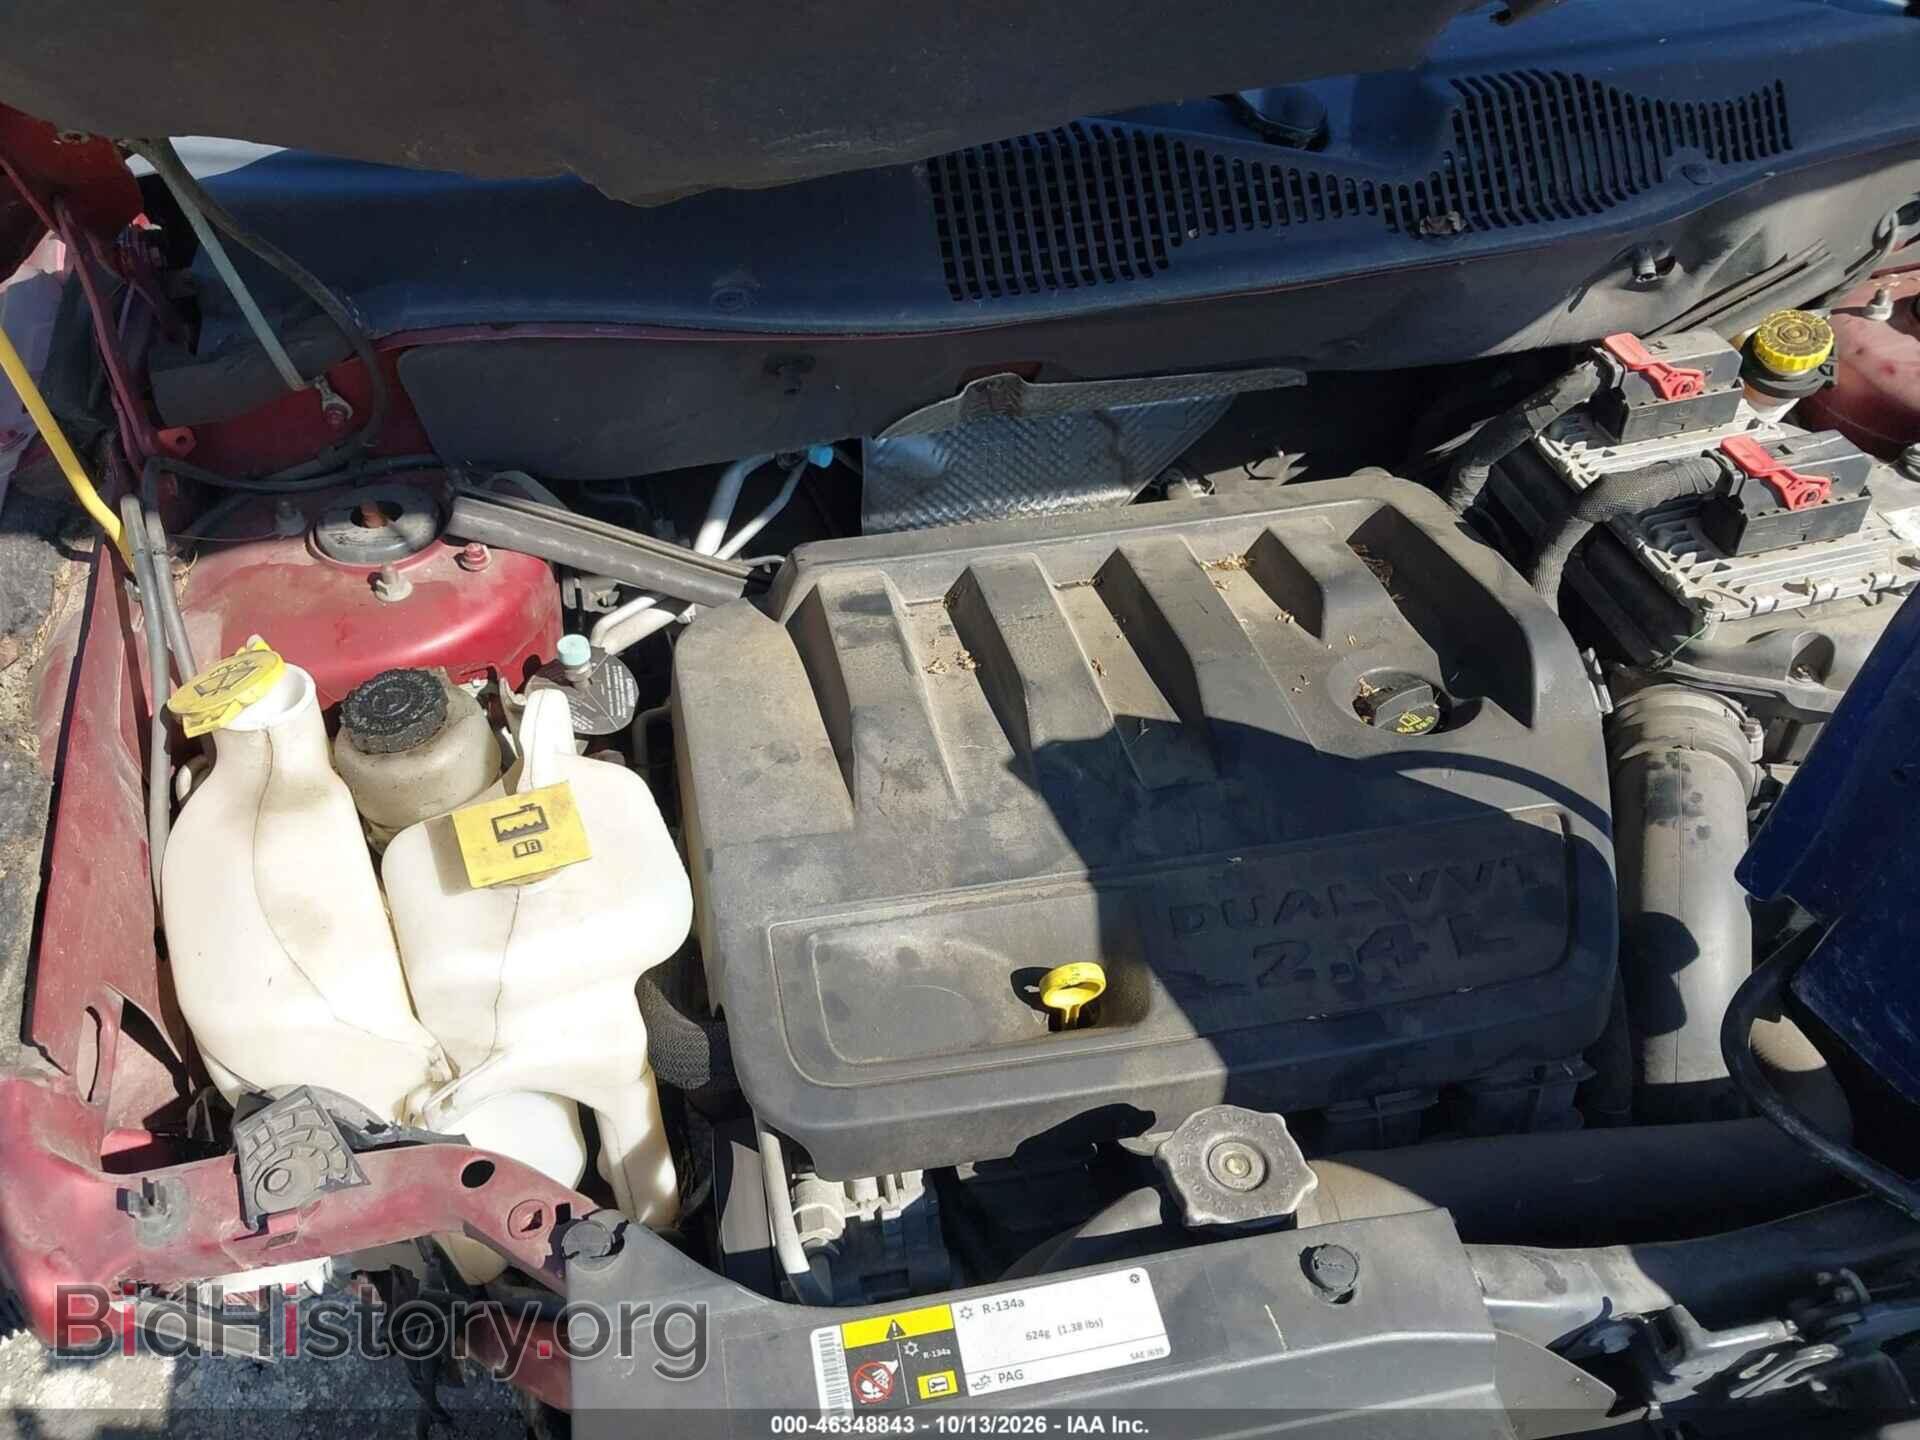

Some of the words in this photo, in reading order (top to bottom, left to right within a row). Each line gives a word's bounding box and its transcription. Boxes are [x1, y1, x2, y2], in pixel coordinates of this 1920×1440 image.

[1167, 882, 1380, 938] DUAL
[981, 1298, 1025, 1316] R-134a
[1024, 1329, 1052, 1342] 624g
[1057, 1320, 1083, 1337] (1.38
[1085, 1316, 1105, 1332] lbs)
[997, 1368, 1024, 1384] PAG
